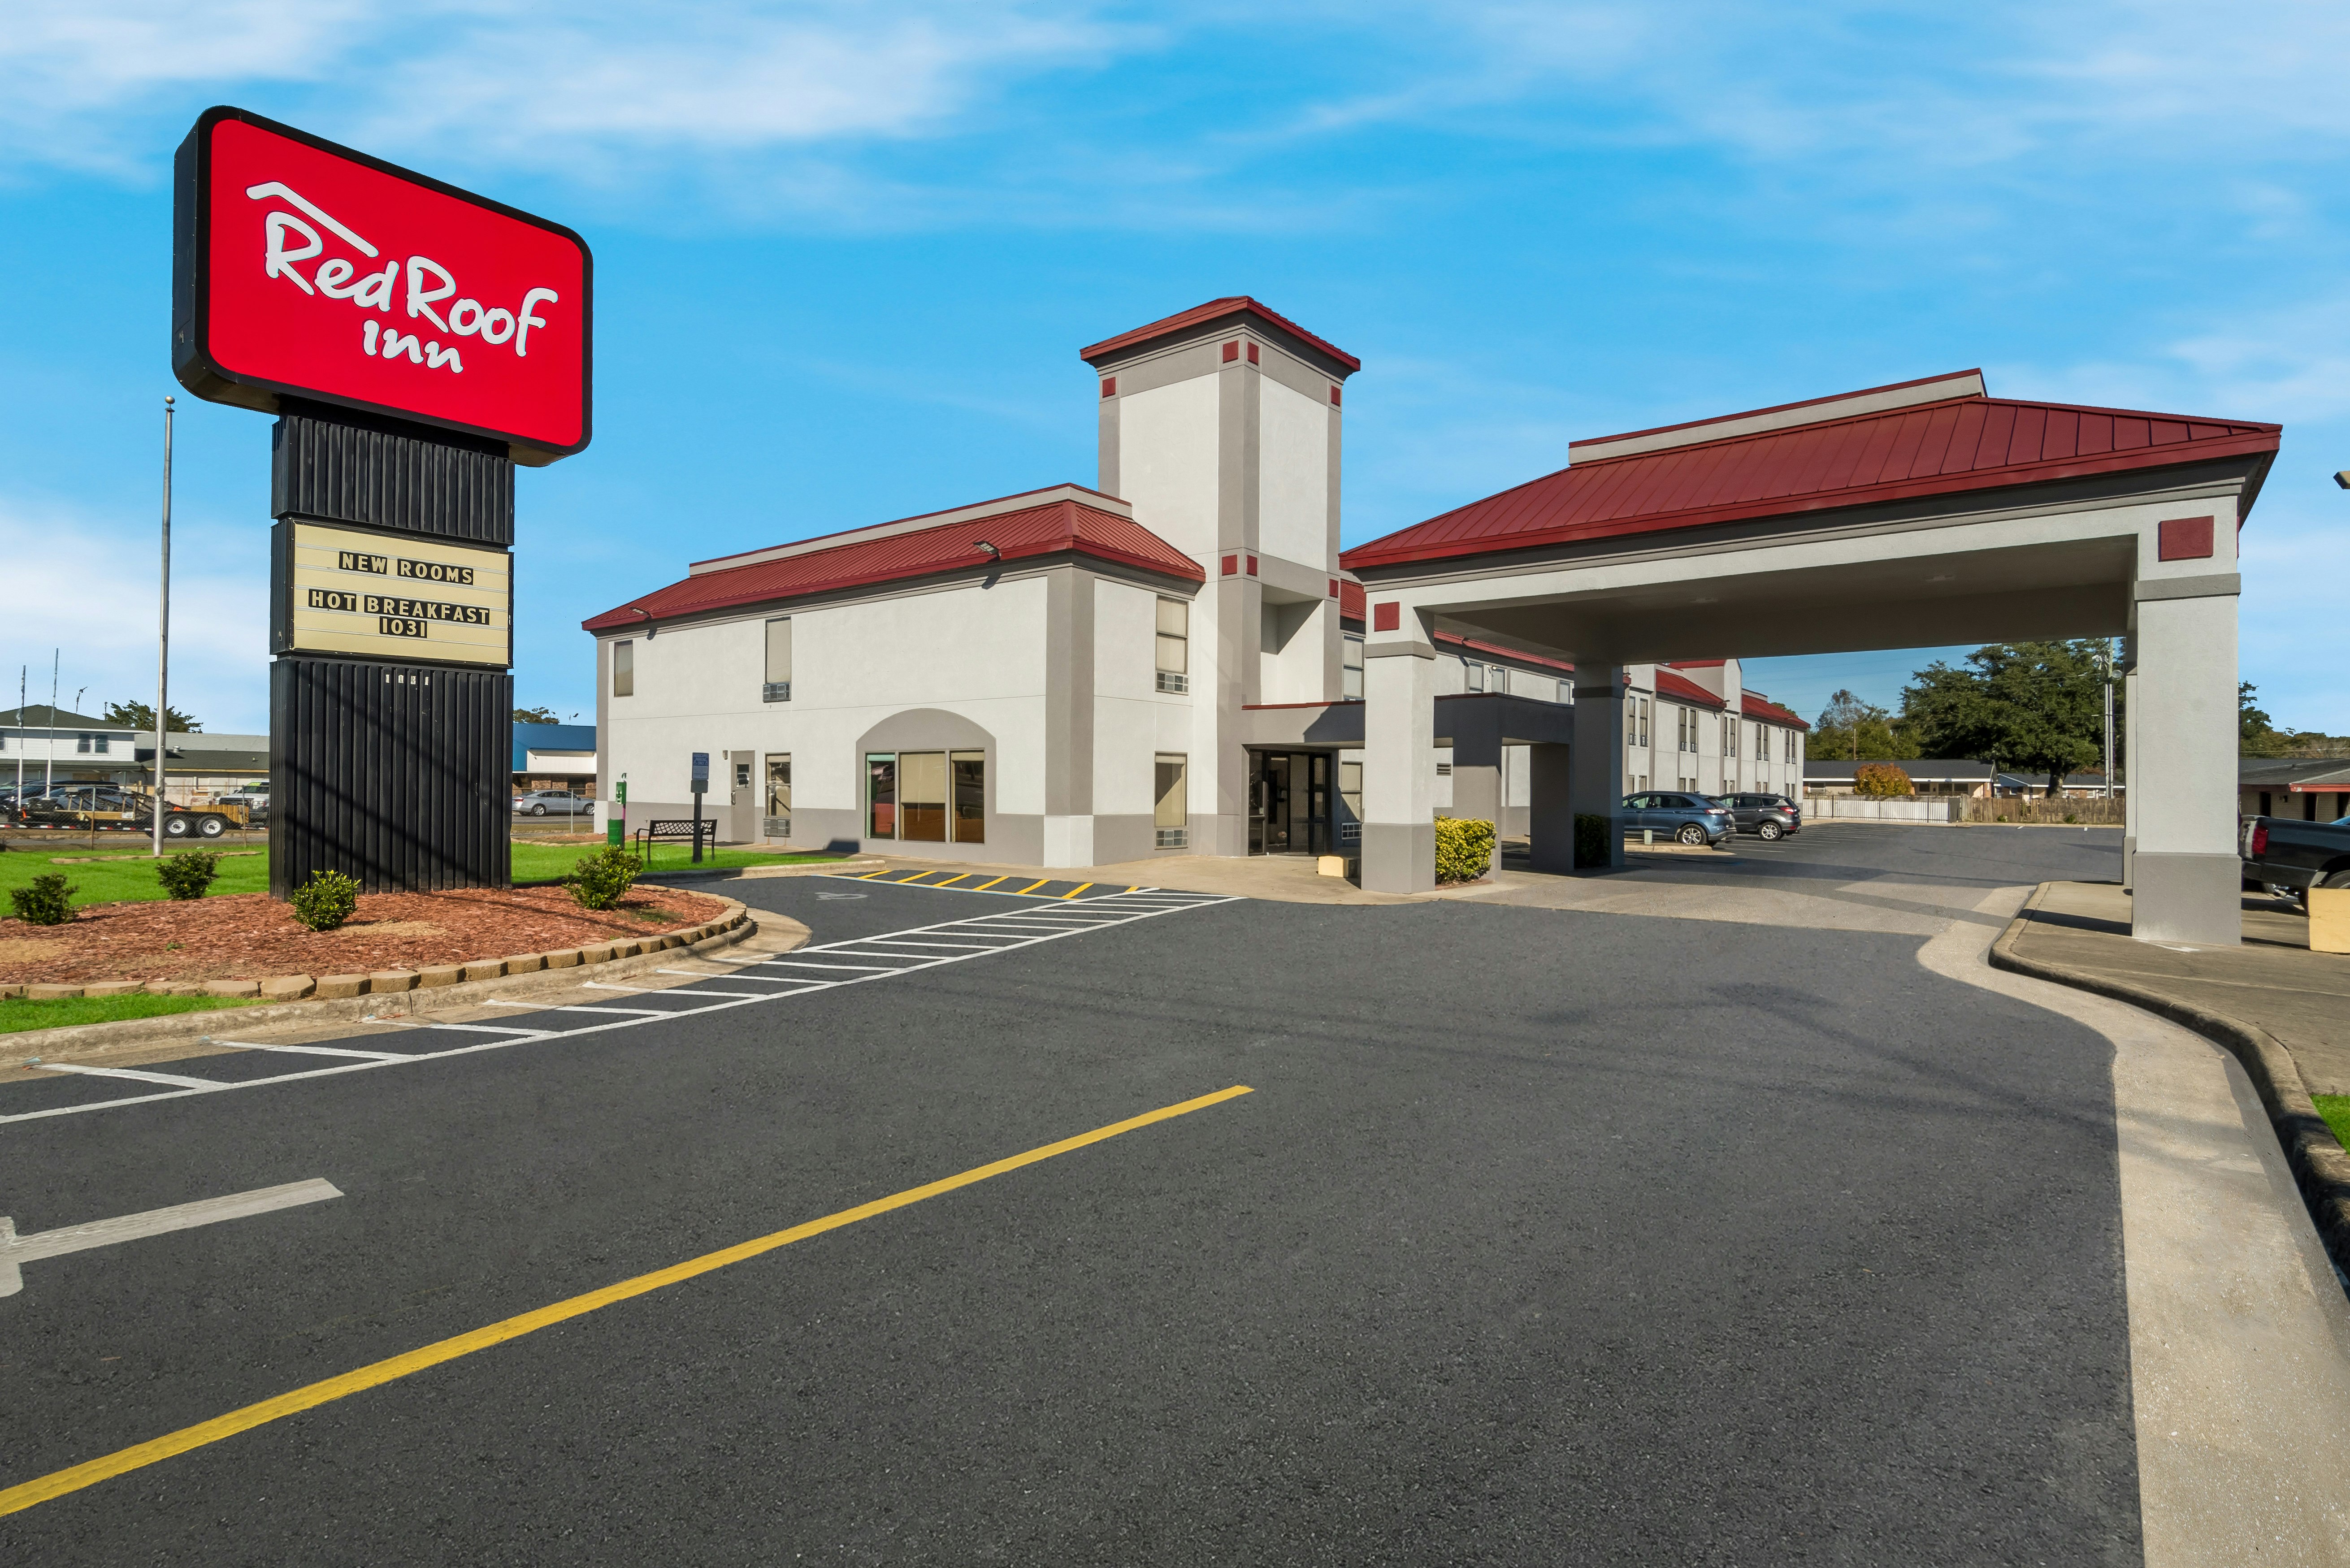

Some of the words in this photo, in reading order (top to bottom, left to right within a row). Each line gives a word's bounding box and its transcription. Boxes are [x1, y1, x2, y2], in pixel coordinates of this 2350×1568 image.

[342, 553, 386, 573] NEW
[400, 560, 472, 583] ROOMS
[312, 591, 355, 610] HOT
[367, 597, 489, 624] BREAKFAST
[382, 618, 425, 637] 1031
